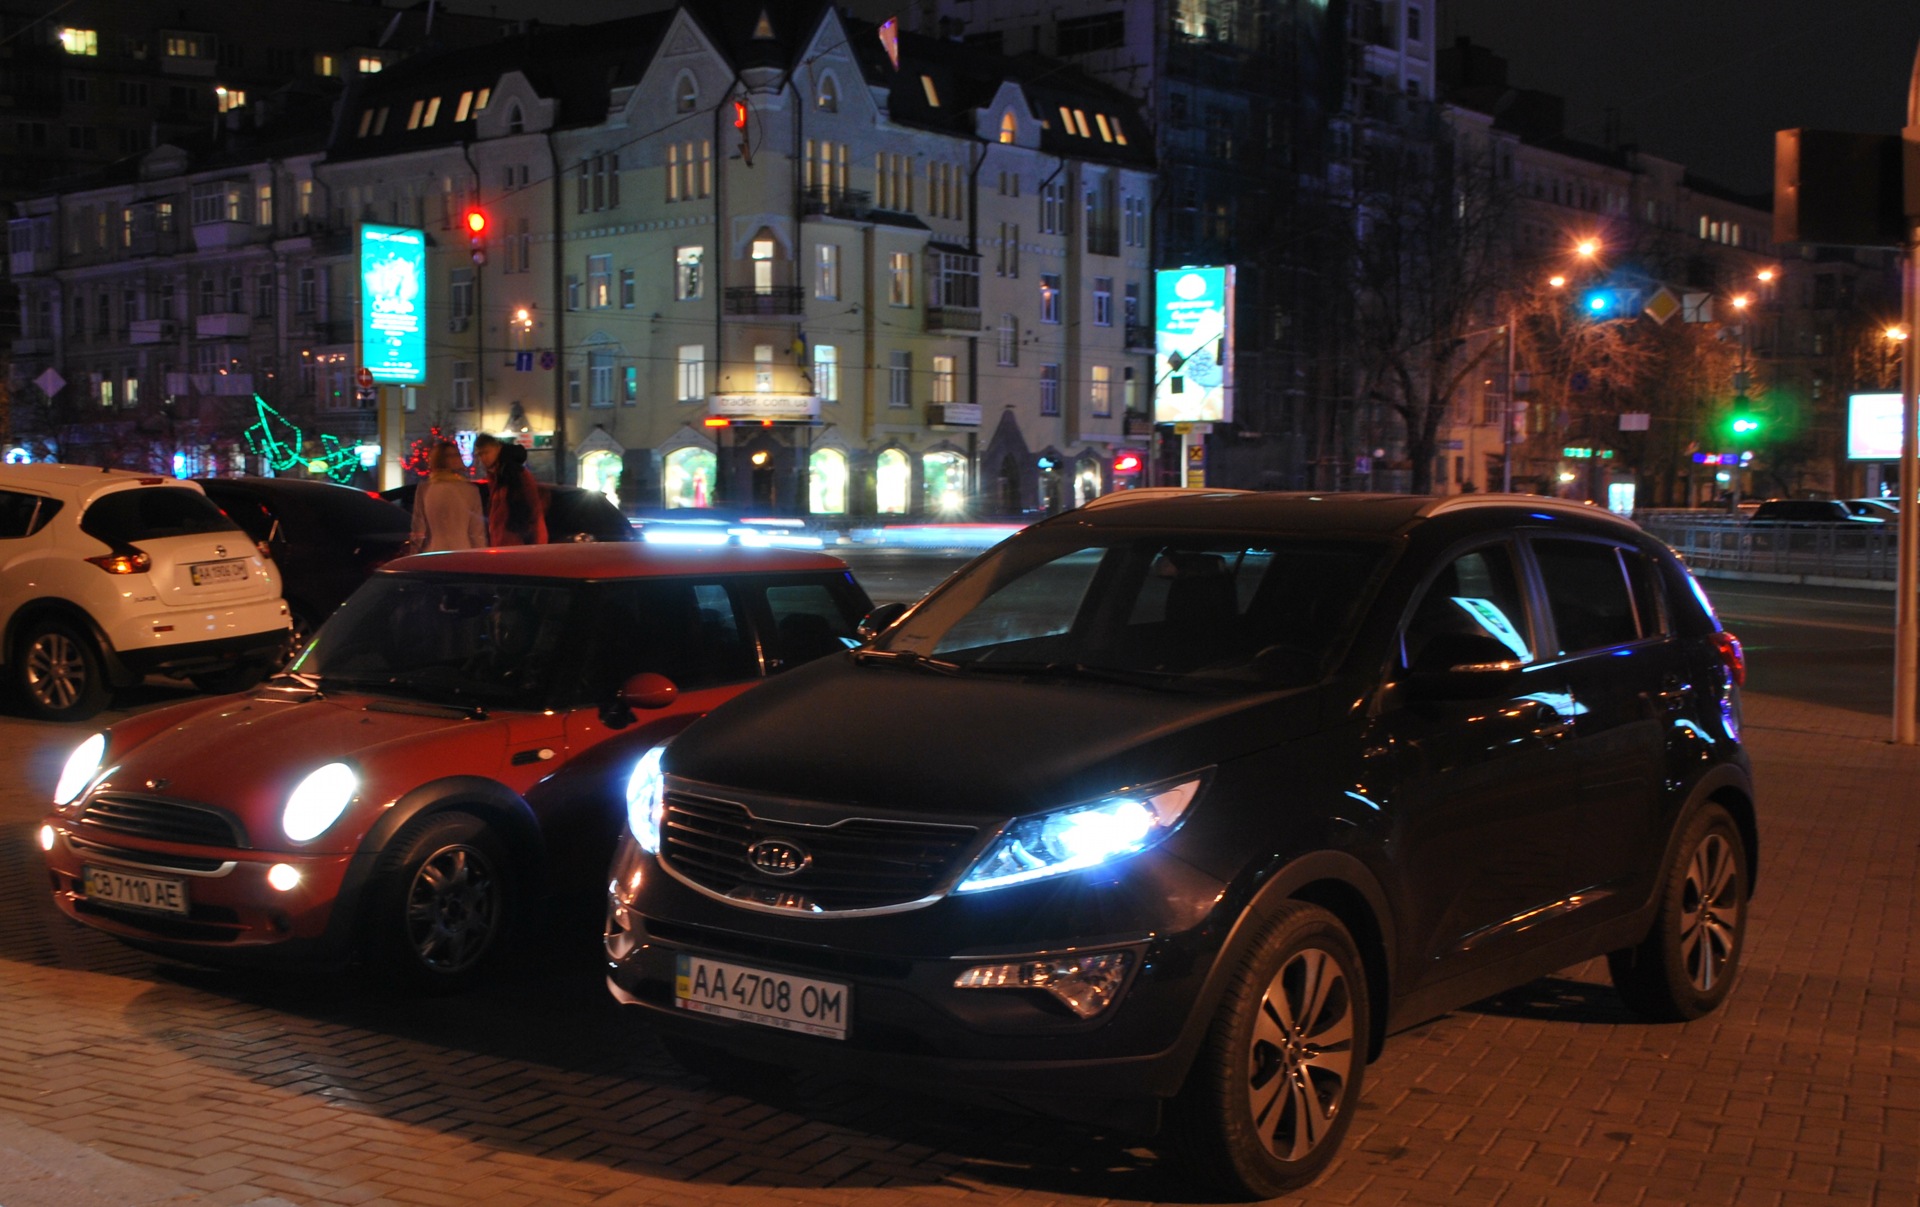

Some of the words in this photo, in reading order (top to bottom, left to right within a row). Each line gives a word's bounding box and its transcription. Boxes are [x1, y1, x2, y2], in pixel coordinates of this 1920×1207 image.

[115, 876, 151, 903] 7110
[156, 882, 179, 908] AE
[693, 964, 728, 1001] AA
[732, 972, 791, 1013] 4708
[801, 985, 841, 1024] OM
